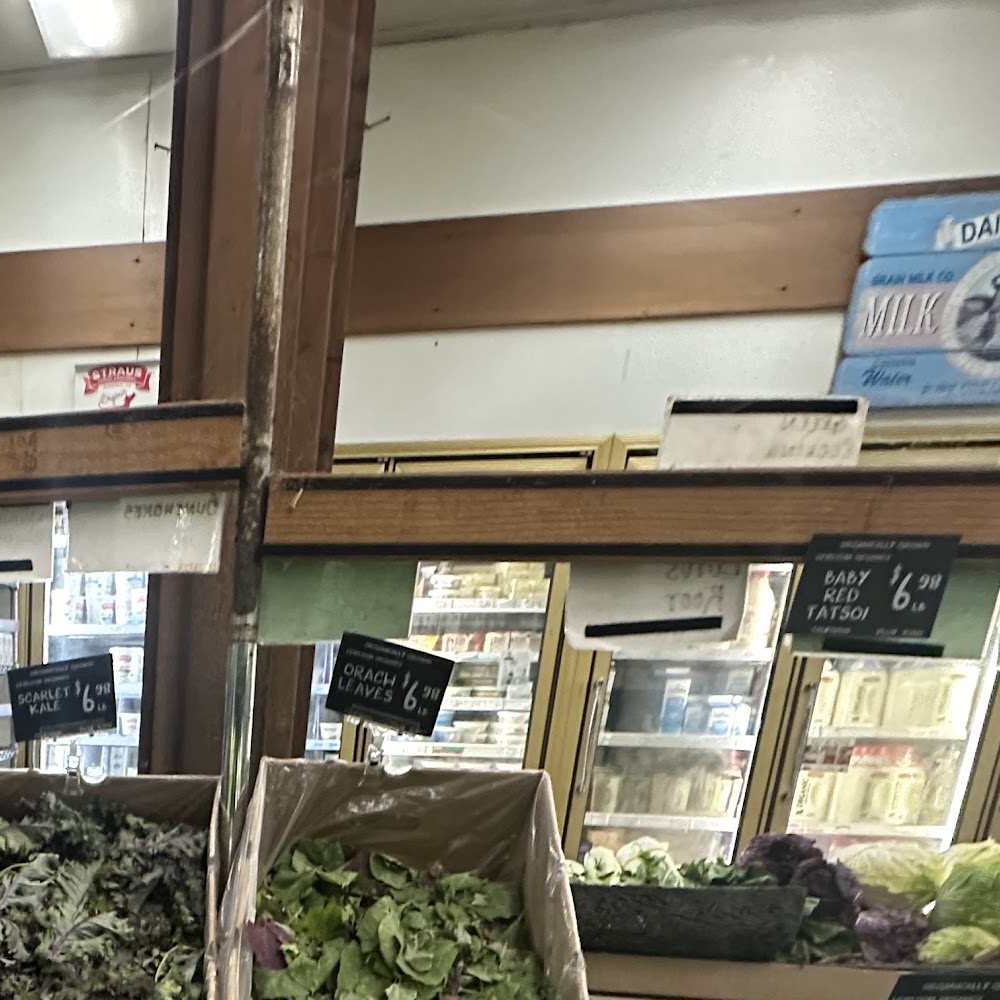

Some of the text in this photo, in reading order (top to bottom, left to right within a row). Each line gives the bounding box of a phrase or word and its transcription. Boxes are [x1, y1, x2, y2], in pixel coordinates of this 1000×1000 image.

[860, 292, 944, 338] MILK
[823, 568, 872, 586] BABY
[823, 586, 860, 603] RED
[807, 604, 870, 622] TATSOI
[343, 663, 397, 687] ORACH
[18, 686, 70, 705] SCARLET
[338, 676, 394, 703] LEAVES
[29, 700, 61, 715] KALE
